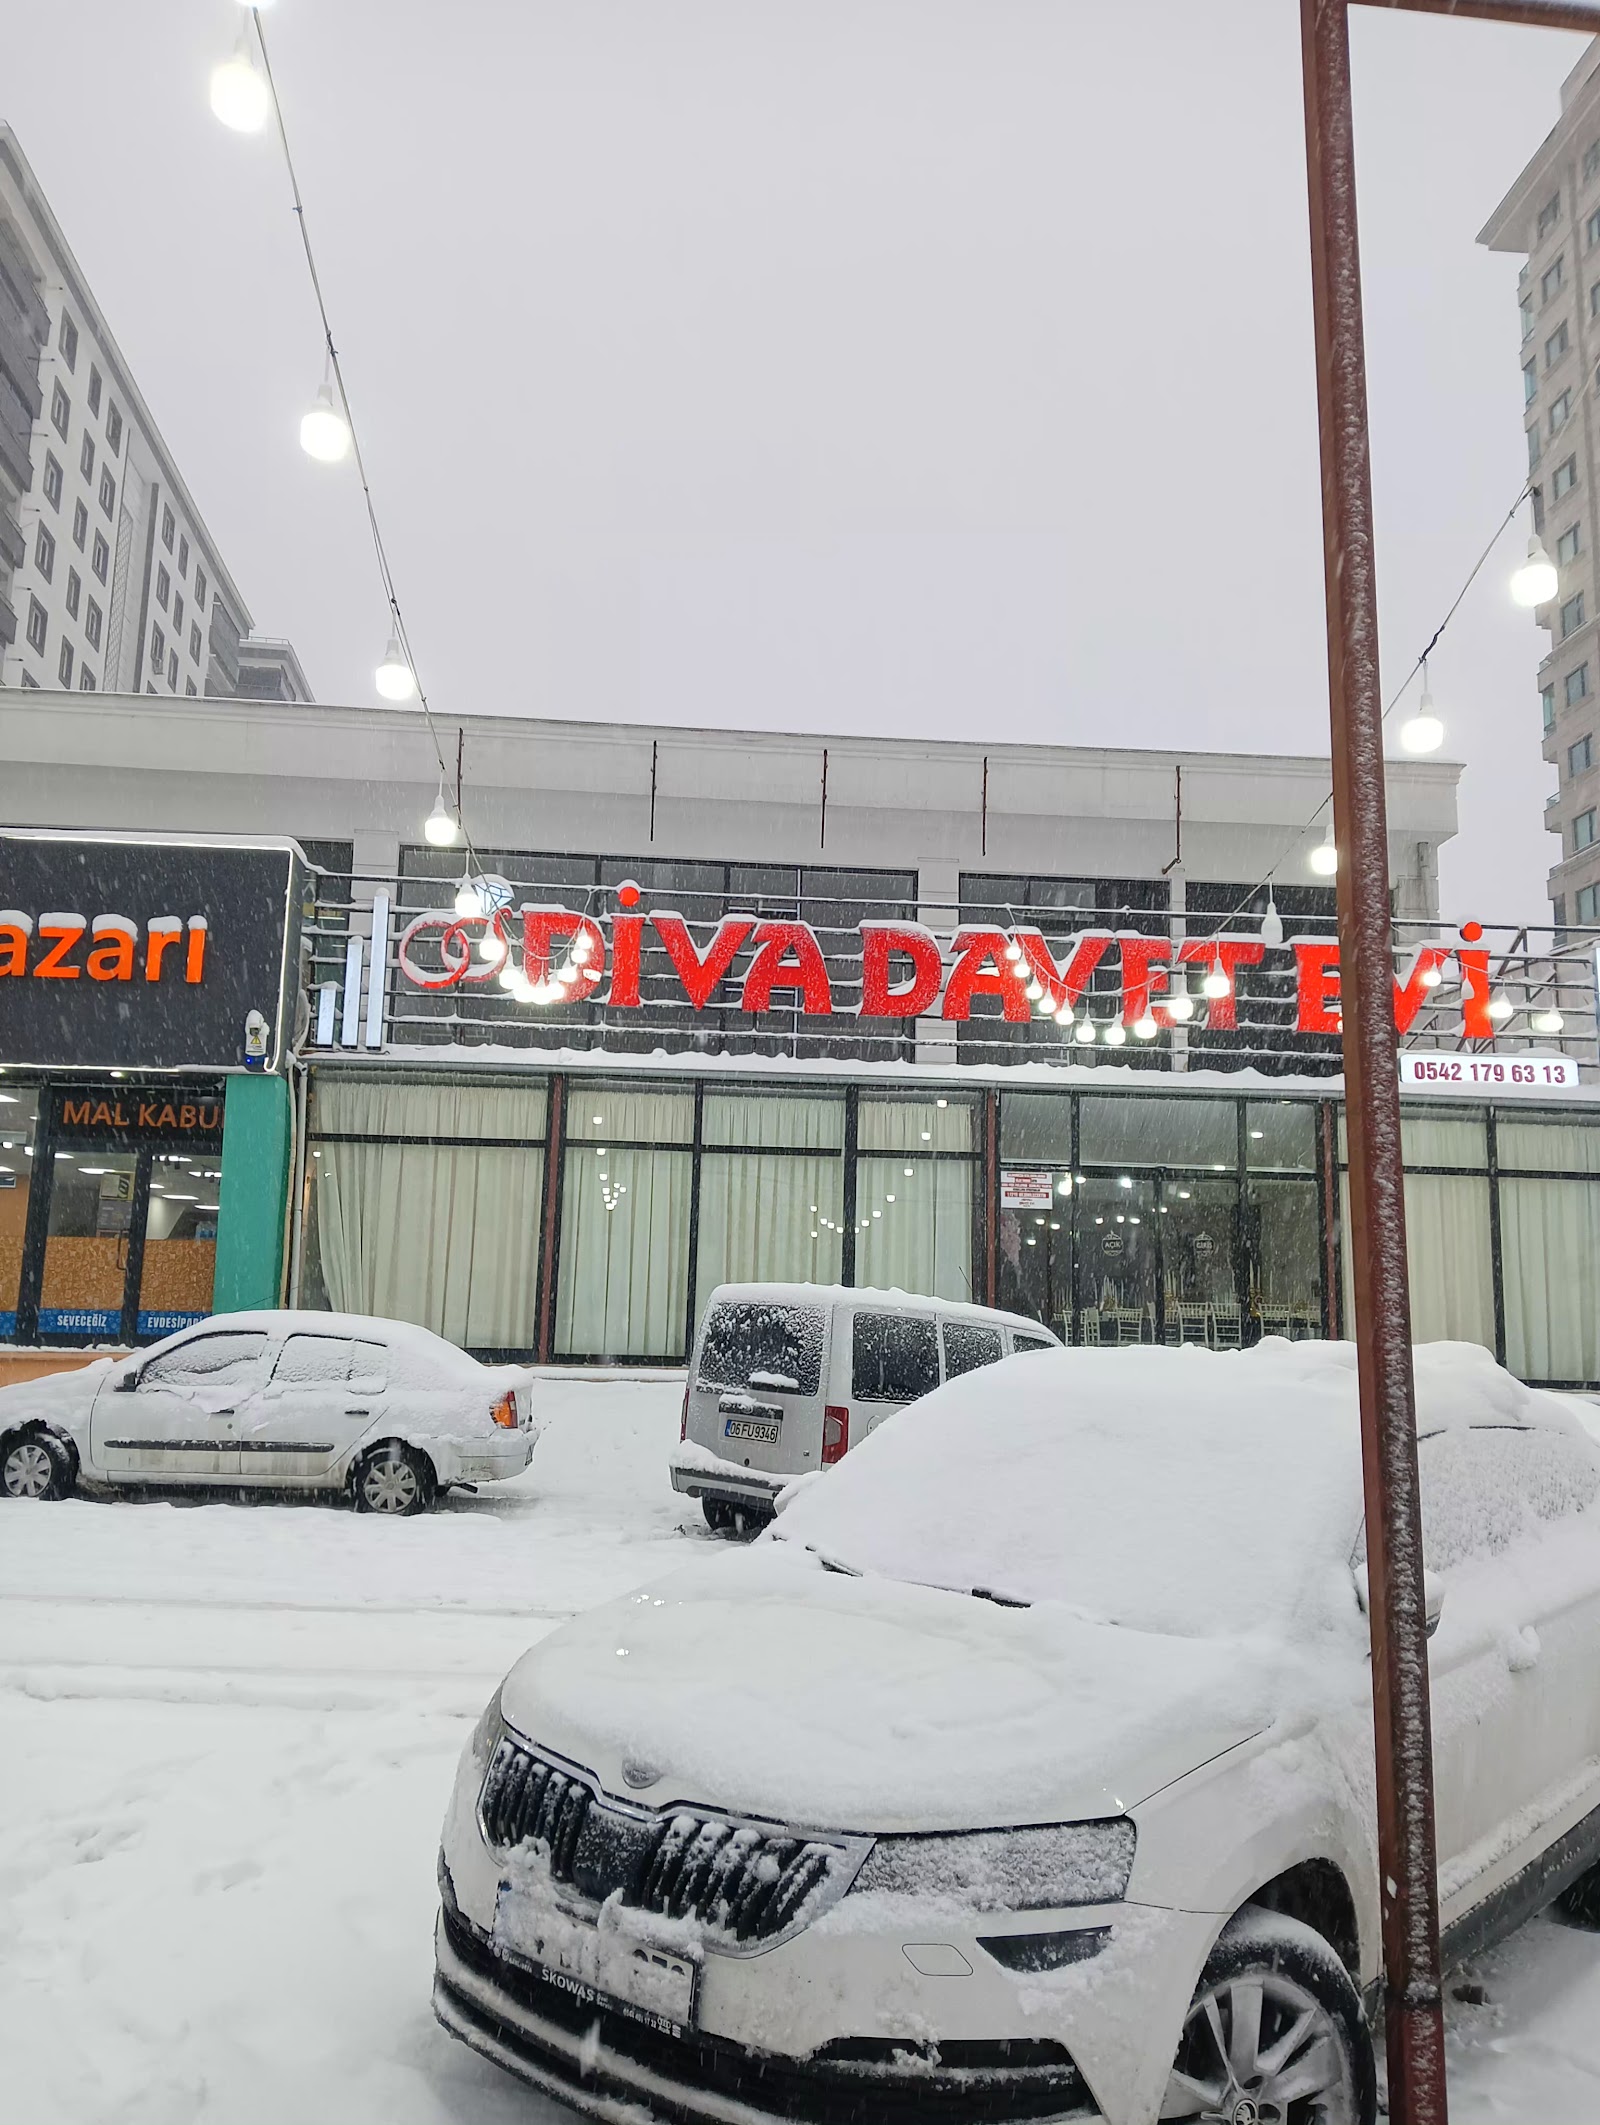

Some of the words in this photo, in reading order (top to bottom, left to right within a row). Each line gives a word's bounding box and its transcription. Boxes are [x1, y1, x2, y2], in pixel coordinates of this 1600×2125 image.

[522, 886, 831, 1014] DİVA
[859, 925, 1265, 1031] DAVET
[1414, 1061, 1462, 1081] 0542
[1470, 1063, 1505, 1082] 179
[1511, 1064, 1535, 1083] 63
[1542, 1065, 1566, 1083] 13
[63, 1100, 129, 1126] MAL
[138, 1103, 224, 1129] KABU
[57, 1313, 107, 1327] SEVECEĞİZ
